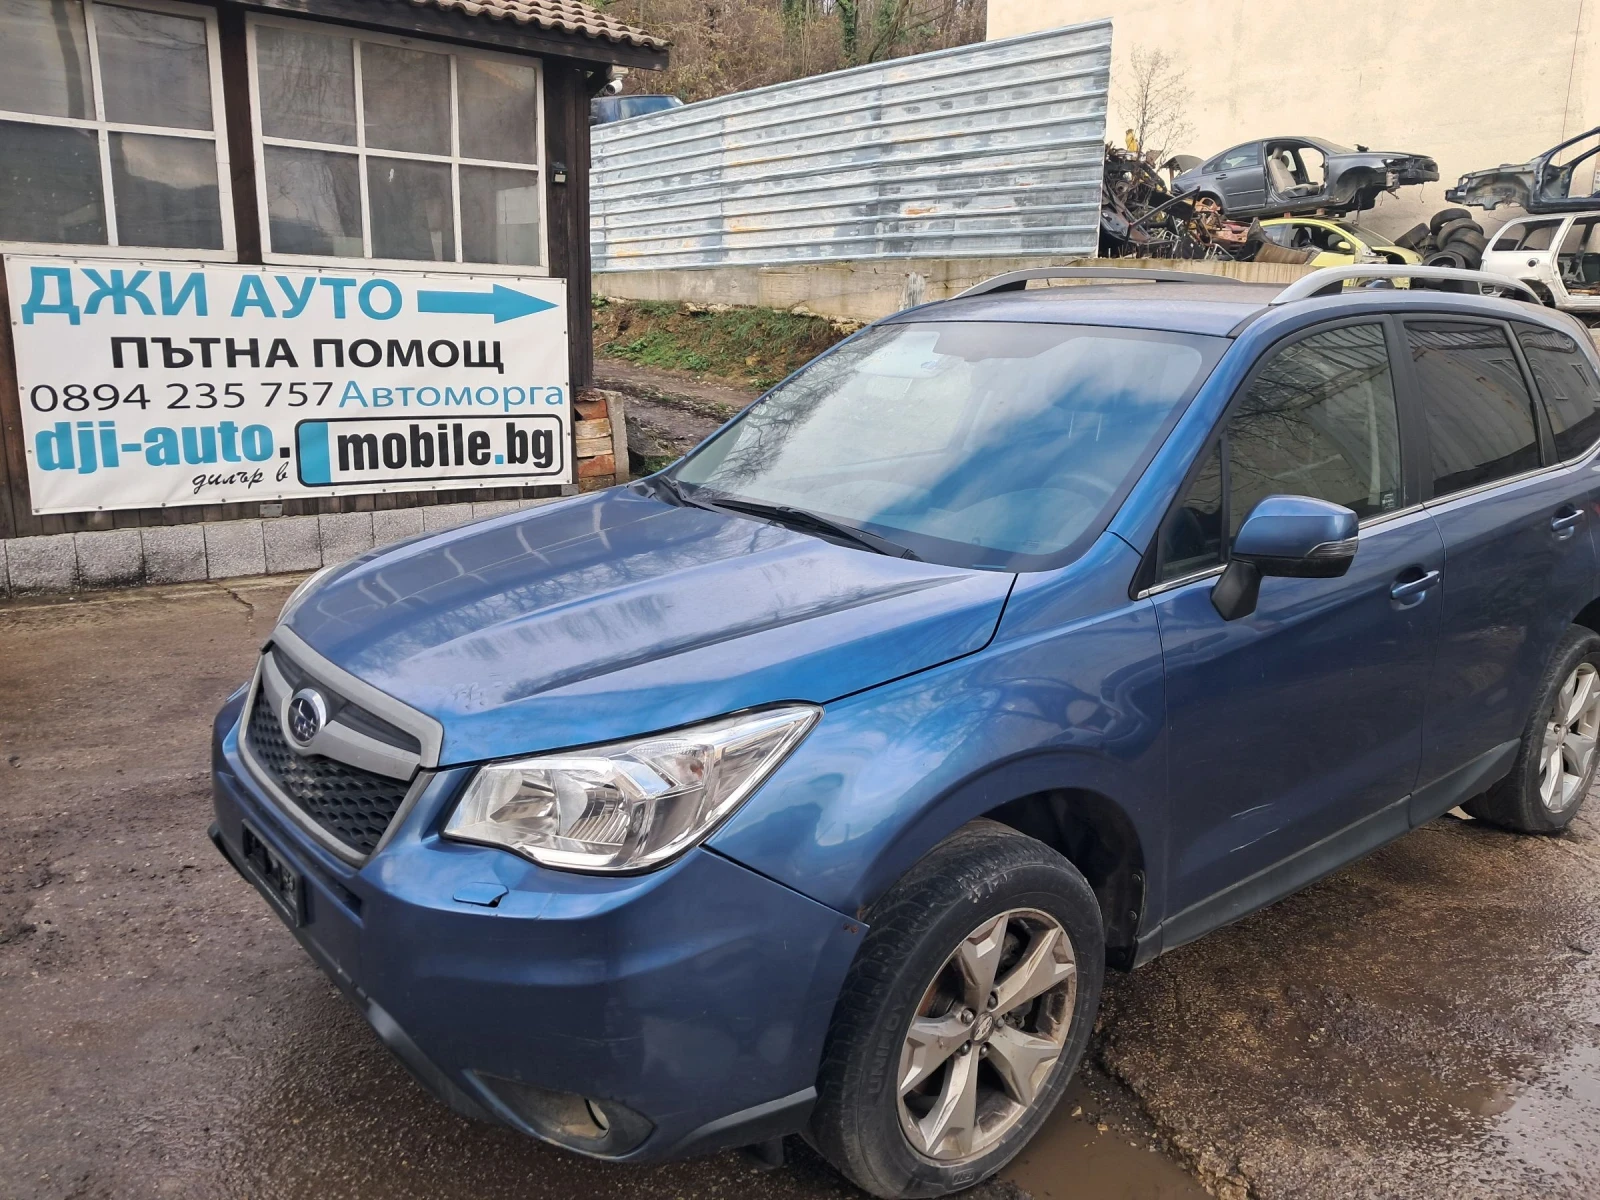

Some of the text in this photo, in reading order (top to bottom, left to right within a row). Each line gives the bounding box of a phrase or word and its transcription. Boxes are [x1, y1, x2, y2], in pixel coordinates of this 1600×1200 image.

[21, 266, 403, 325] ДЖИ АУТО
[110, 336, 504, 374] ПЪТНА ПОМОЩ
[30, 380, 564, 412] 0894 235 757 Автоморга
[337, 423, 554, 471] mobile.bg
[192, 461, 289, 494] дилър в
